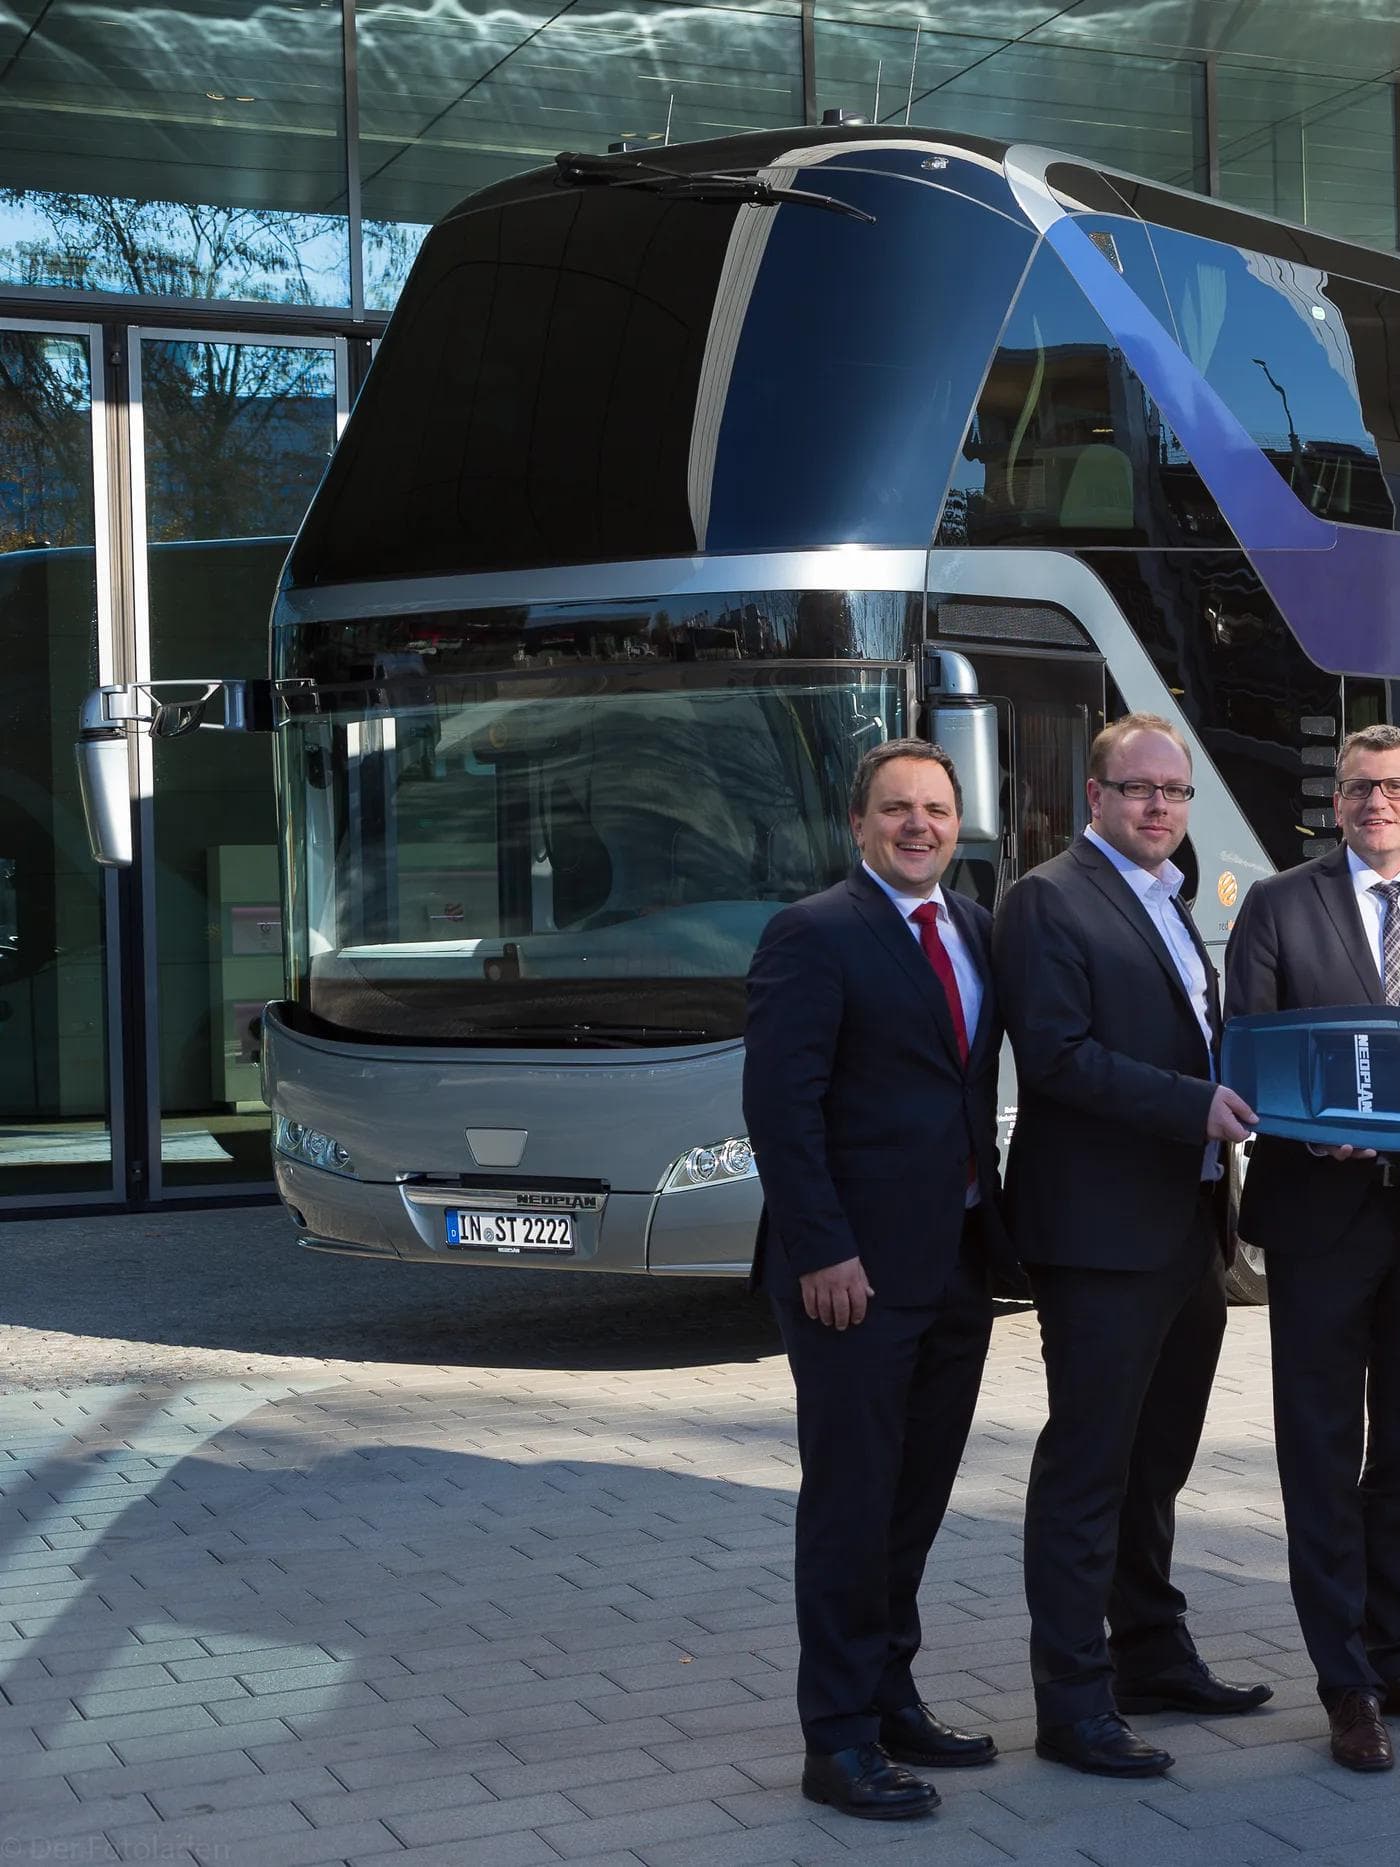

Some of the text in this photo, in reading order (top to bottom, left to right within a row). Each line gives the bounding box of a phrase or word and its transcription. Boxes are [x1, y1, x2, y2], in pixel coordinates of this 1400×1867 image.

[1354, 1033, 1374, 1114] NEOPLAN
[516, 1194, 597, 1210] NEOPLAN
[451, 1214, 570, 1245] D IN ST 2222
